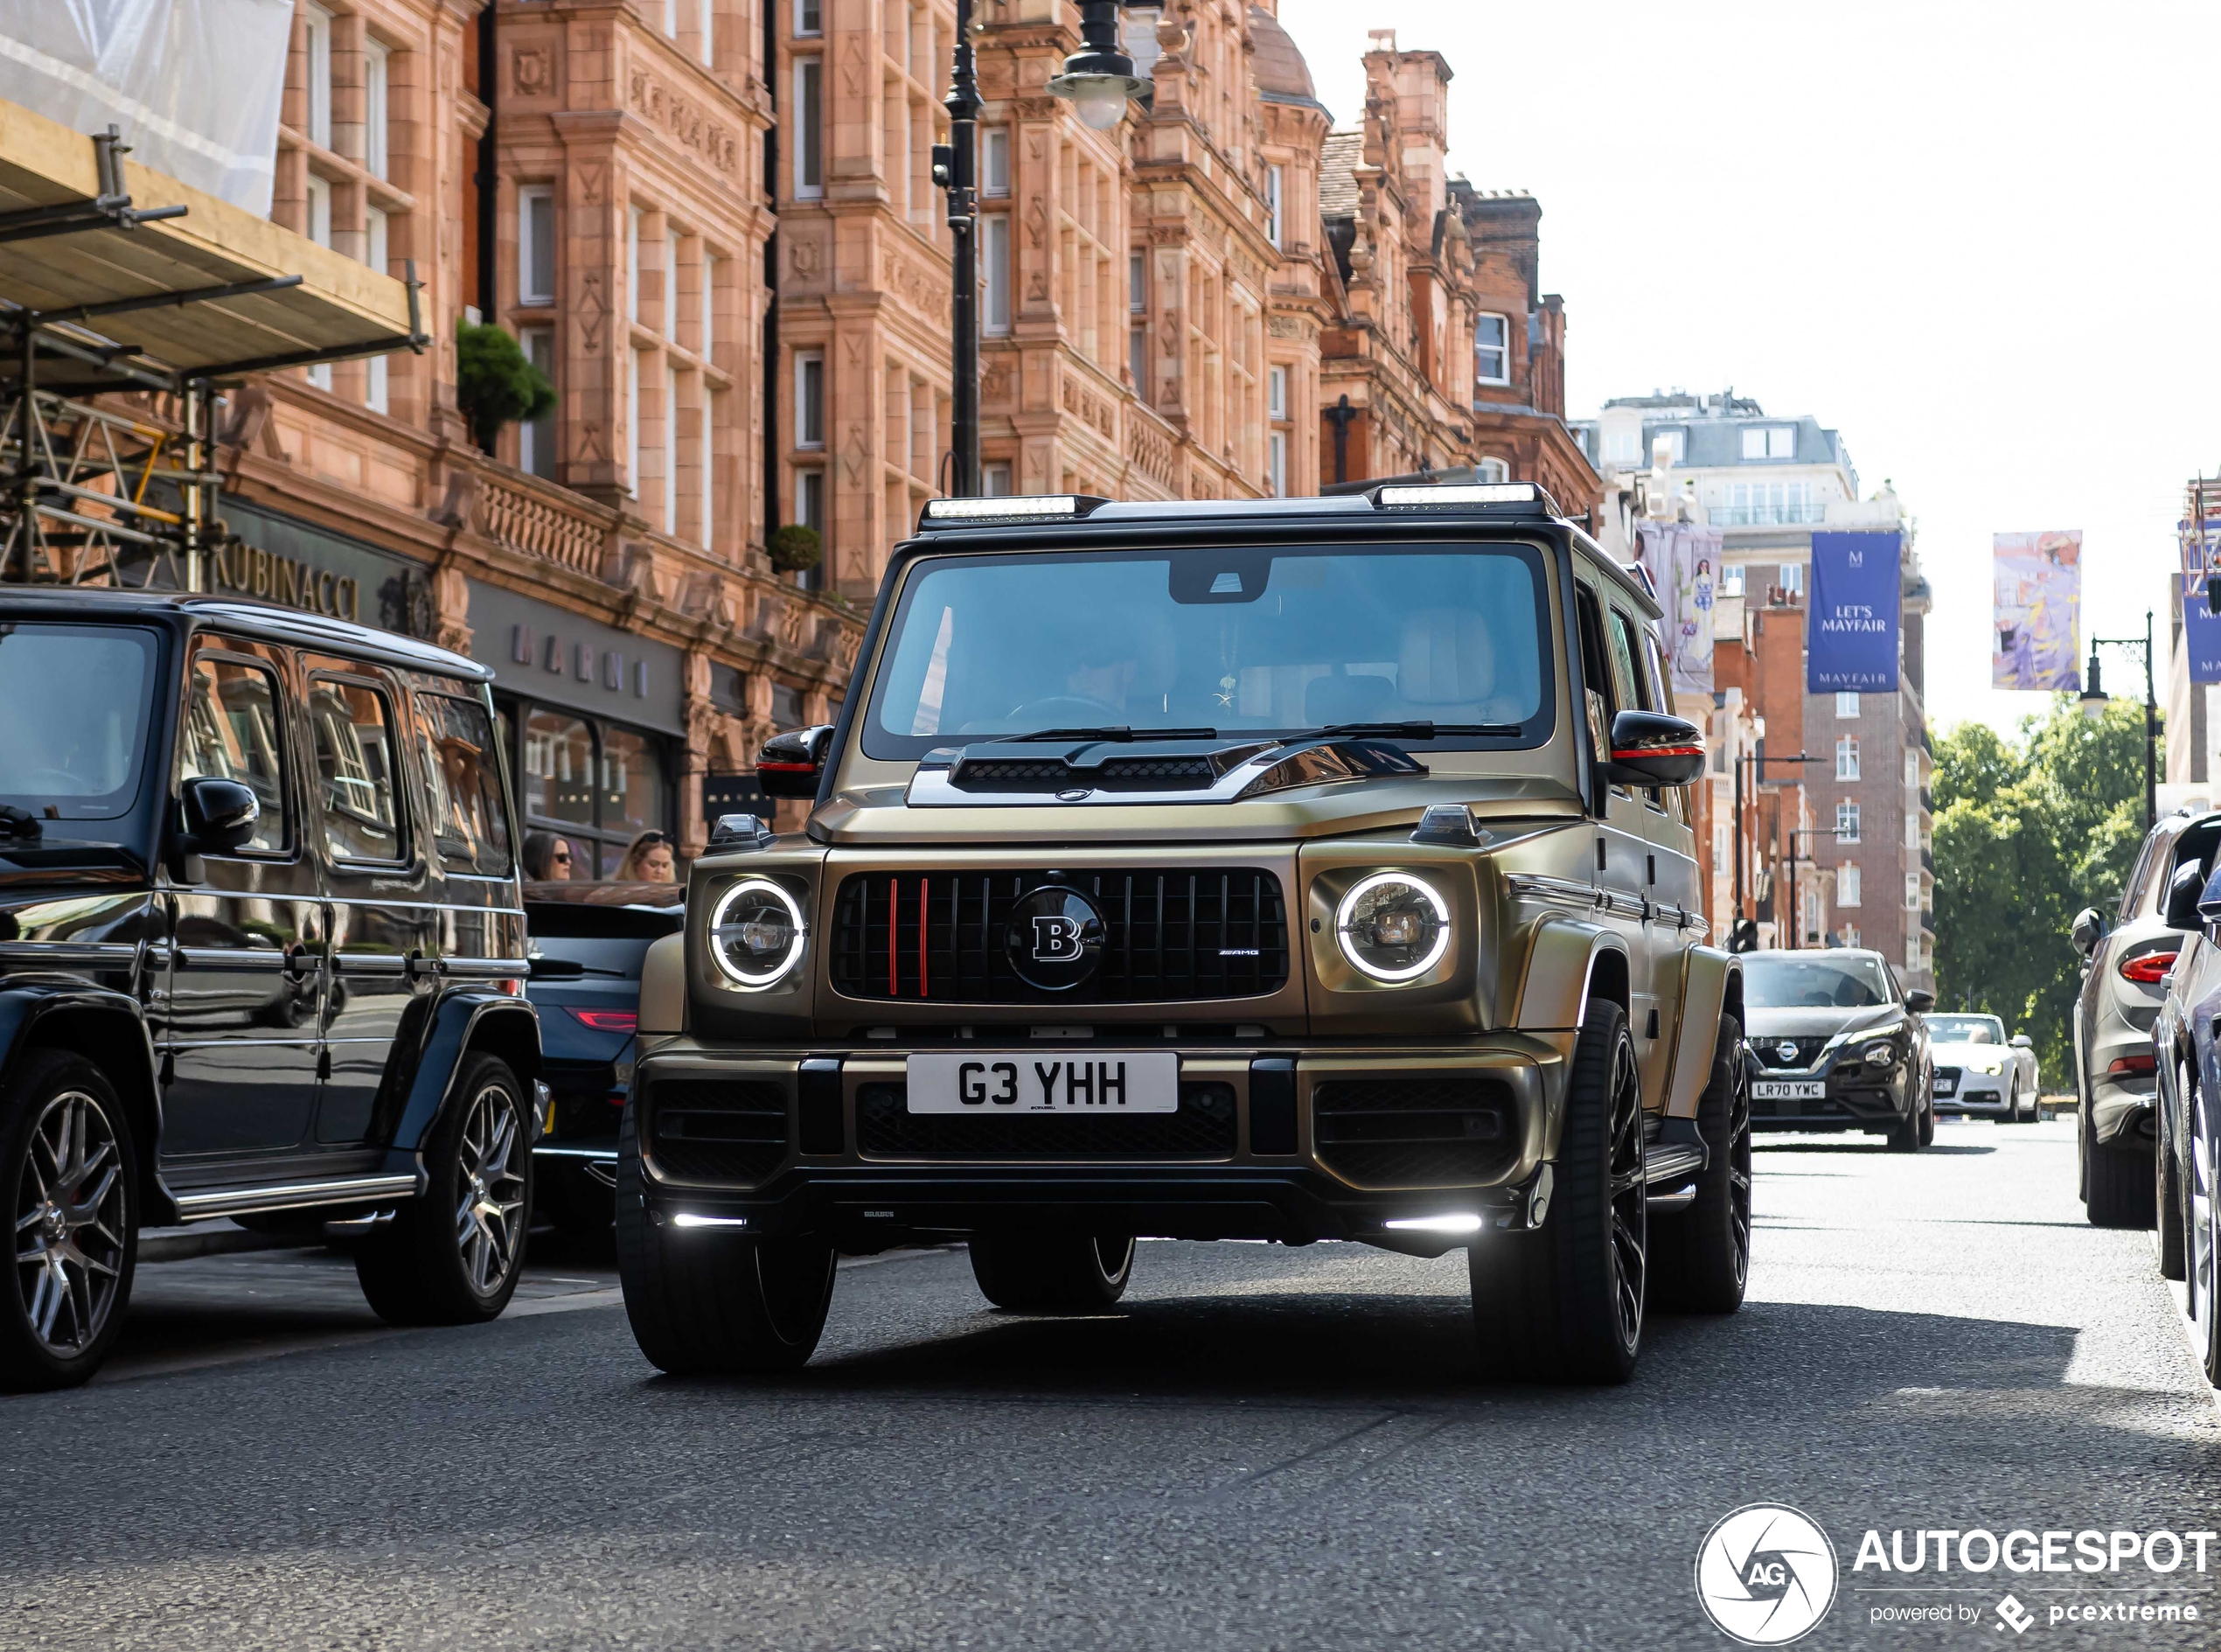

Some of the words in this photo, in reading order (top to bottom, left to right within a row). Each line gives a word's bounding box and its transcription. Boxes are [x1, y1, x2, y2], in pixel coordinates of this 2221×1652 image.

[1836, 604, 1872, 619] LET'S
[1821, 619, 1886, 632] MAYFAIR
[1820, 673, 1886, 684] MAYFAIR
[1033, 916, 1084, 962] B
[959, 1062, 1019, 1105] G3
[1034, 1061, 1126, 1105] YHH
[1758, 1084, 1791, 1096] LR70
[1795, 1084, 1819, 1096] YWC
